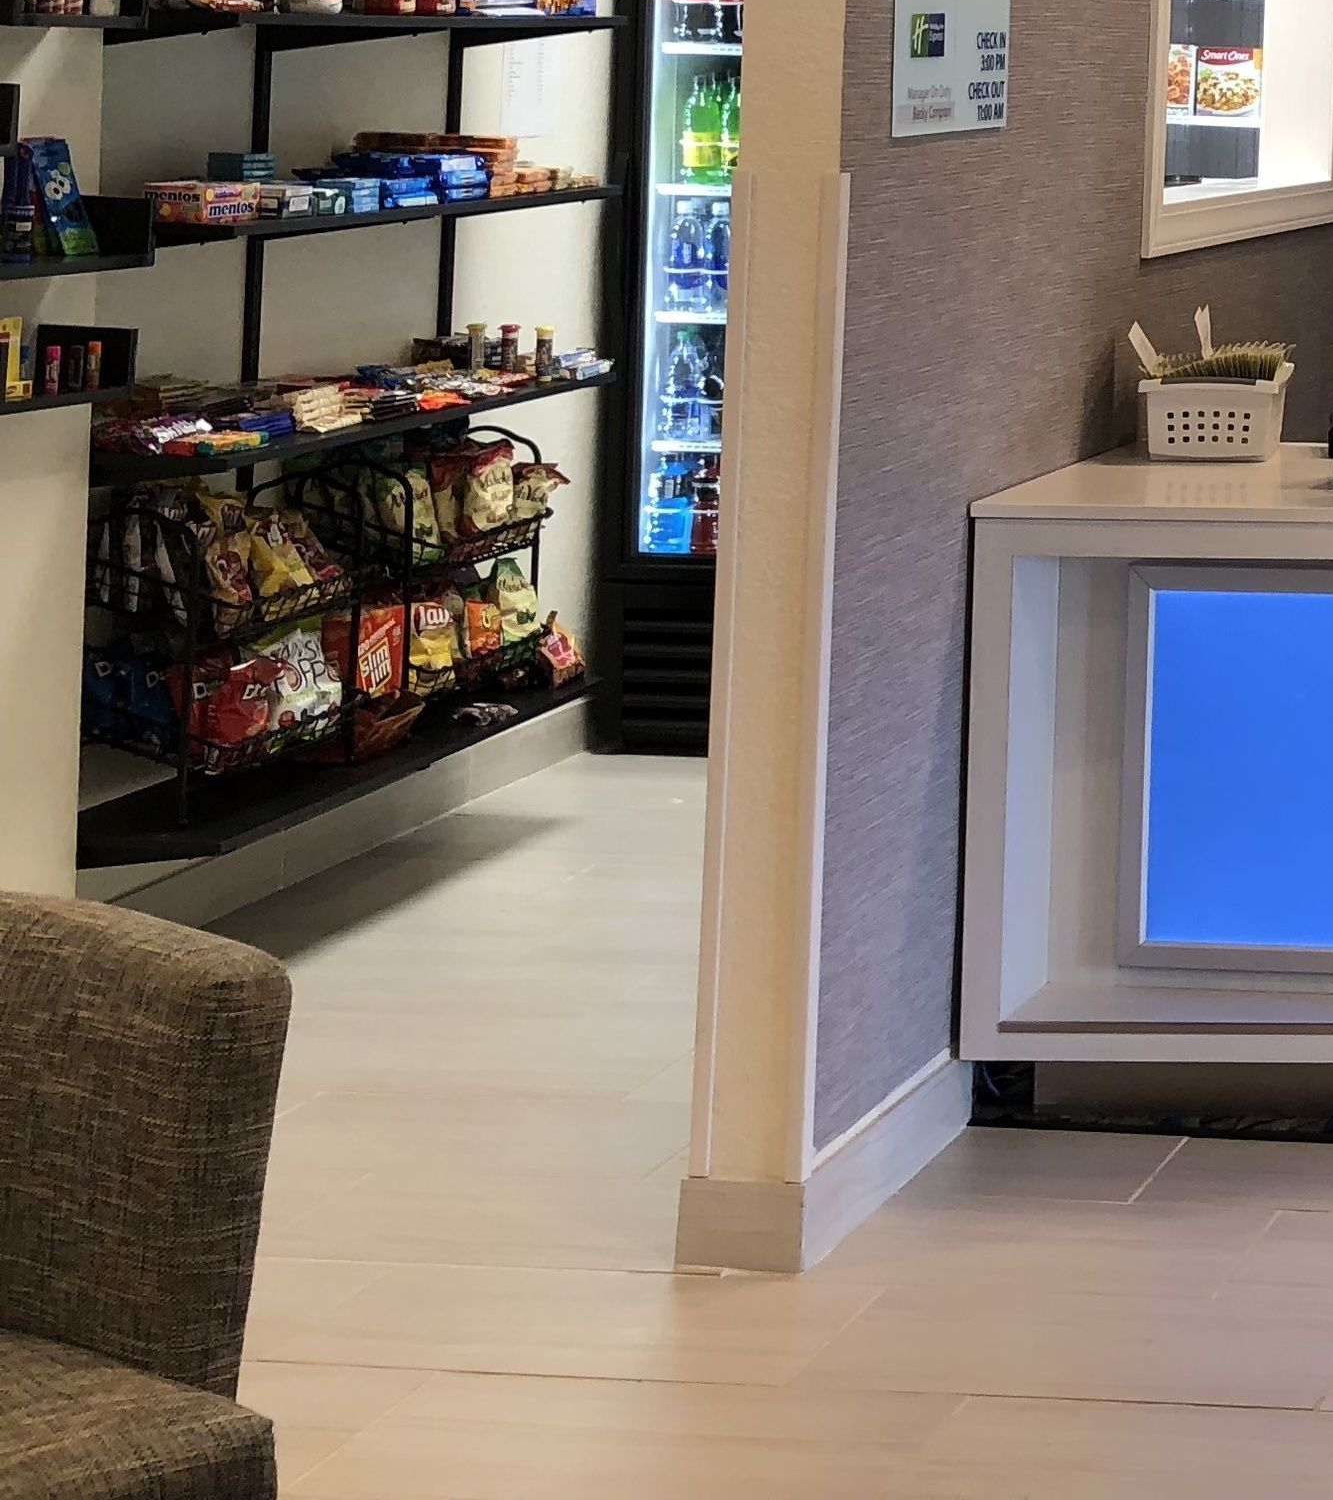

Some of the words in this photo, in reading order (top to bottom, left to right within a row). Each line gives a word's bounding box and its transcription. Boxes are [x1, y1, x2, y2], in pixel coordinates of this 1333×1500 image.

[977, 31, 998, 50] CHECK
[1000, 31, 1007, 49] IN
[980, 53, 995, 71] 3:00
[996, 53, 1006, 71] PM
[1201, 49, 1228, 62] Smart
[1228, 50, 1250, 61] Ones
[968, 82, 990, 101] CHECK
[991, 80, 1005, 99] OUT
[978, 104, 993, 121] 11:00
[994, 102, 1005, 120] AM
[144, 190, 200, 202] mentos
[208, 200, 255, 217] mentos
